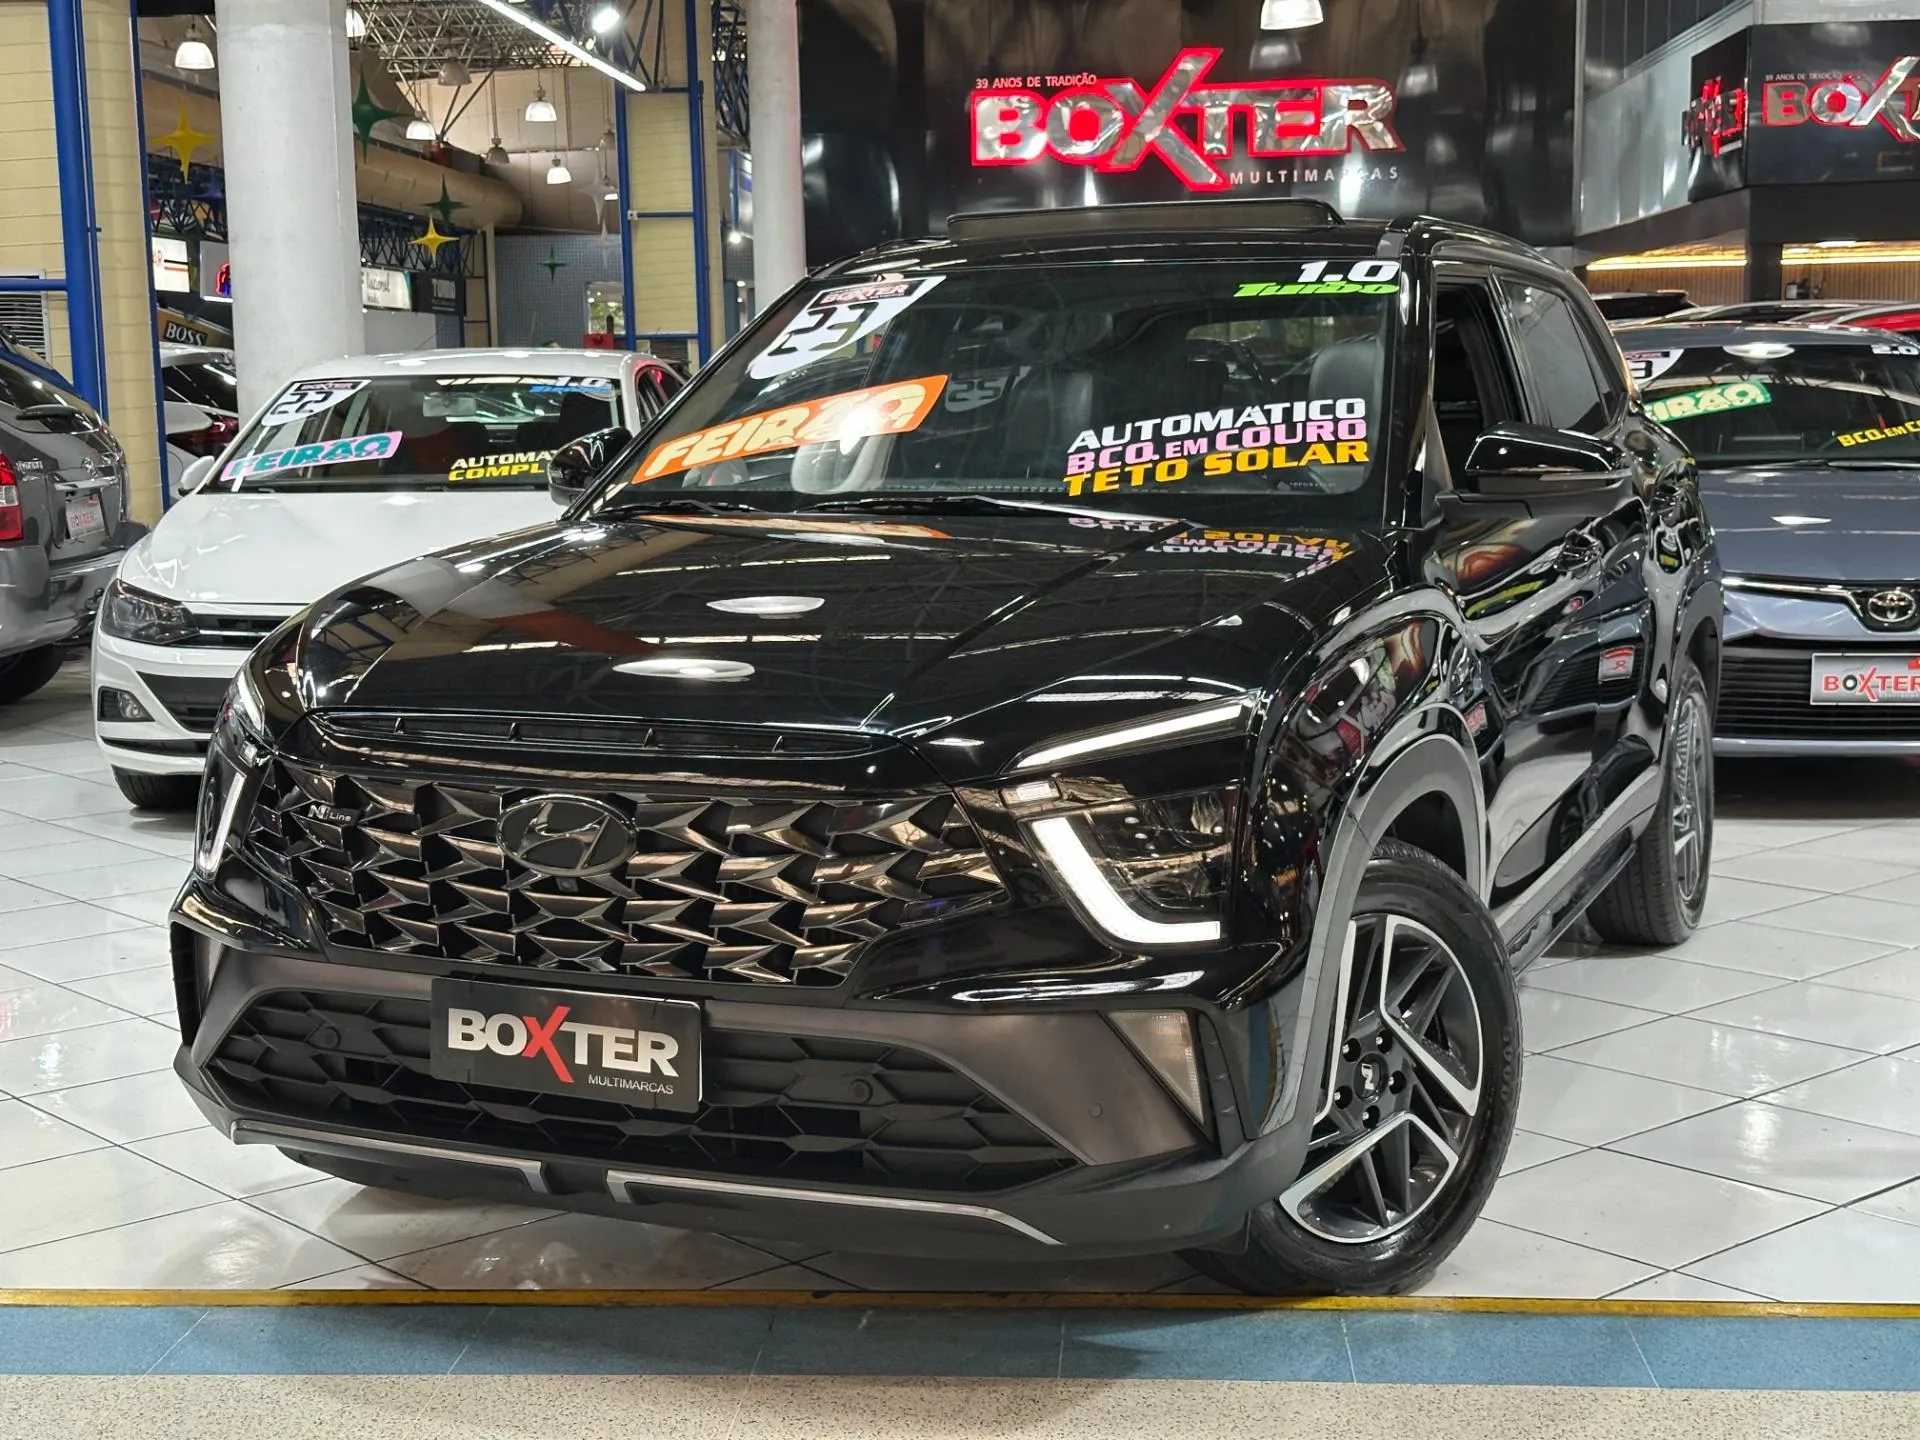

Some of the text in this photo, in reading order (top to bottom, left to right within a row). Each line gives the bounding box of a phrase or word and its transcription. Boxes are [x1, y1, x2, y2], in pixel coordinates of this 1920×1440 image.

[975, 72, 1097, 89] 39 ANOS DE TRADIÇÃO
[970, 47, 1406, 192] BOXTER
[1229, 166, 1399, 186] MULTIMACAS
[1297, 260, 1401, 283] 1.0
[165, 322, 206, 346] BOSS
[767, 301, 881, 357] 23
[270, 391, 334, 415] 22
[1165, 437, 1208, 459] EM
[1215, 419, 1367, 451] COURO
[1063, 441, 1370, 497] TETO SOLAR
[448, 1006, 679, 1083] BOXTER
[588, 1074, 674, 1095] MULTIMARCAS
